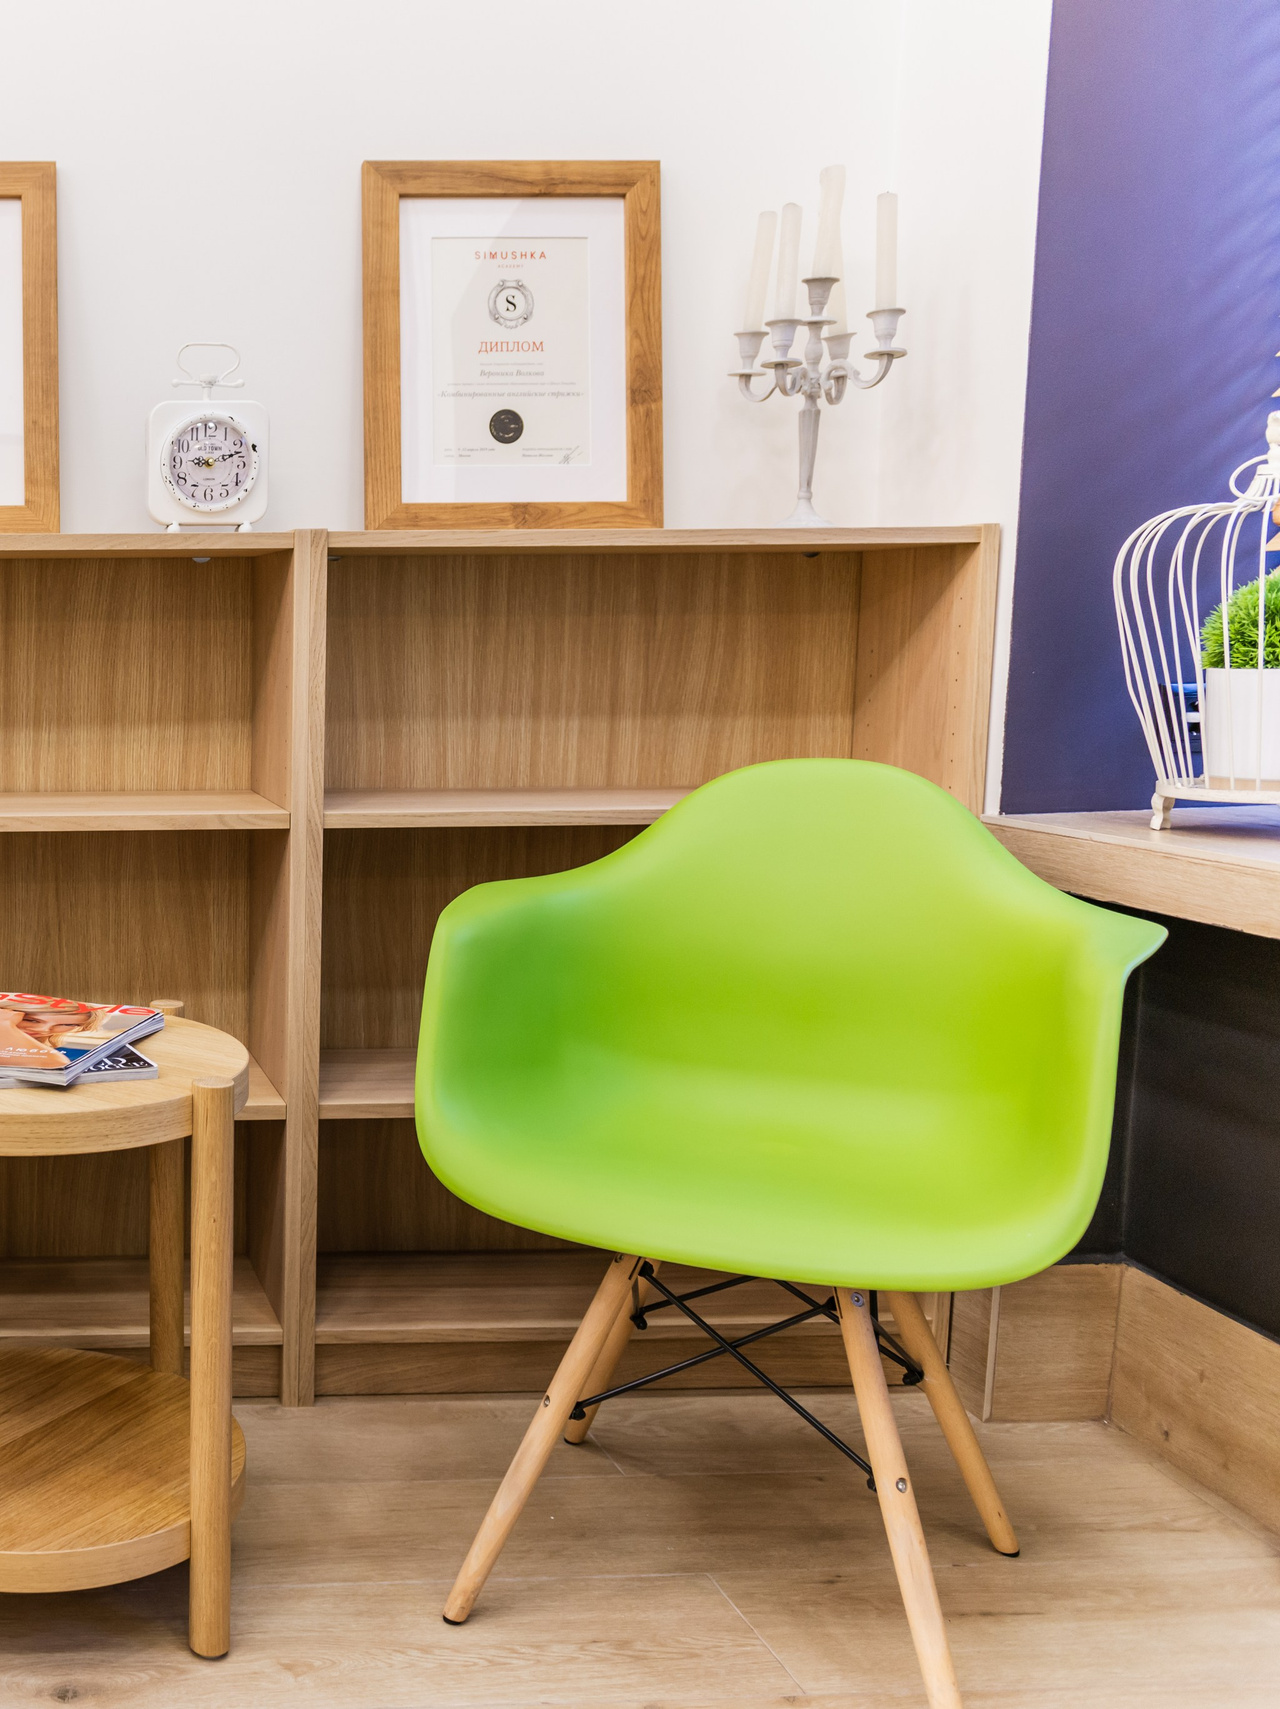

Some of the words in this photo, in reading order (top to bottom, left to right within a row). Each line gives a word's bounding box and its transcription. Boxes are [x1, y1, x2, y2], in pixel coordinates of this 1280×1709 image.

[474, 251, 547, 260] SIMUSHKA
[505, 294, 517, 312] S
[478, 341, 544, 354] ДИПЛОМ
[480, 369, 514, 379] Вероника
[191, 427, 199, 441] 11
[204, 423, 218, 438] 12
[177, 438, 190, 453] 10
[233, 439, 243, 453] 2
[173, 455, 183, 469] 9
[177, 471, 187, 486] 8
[230, 473, 241, 487] 4
[191, 484, 199, 498] 7
[203, 487, 213, 501] 6
[219, 484, 229, 498] 5
